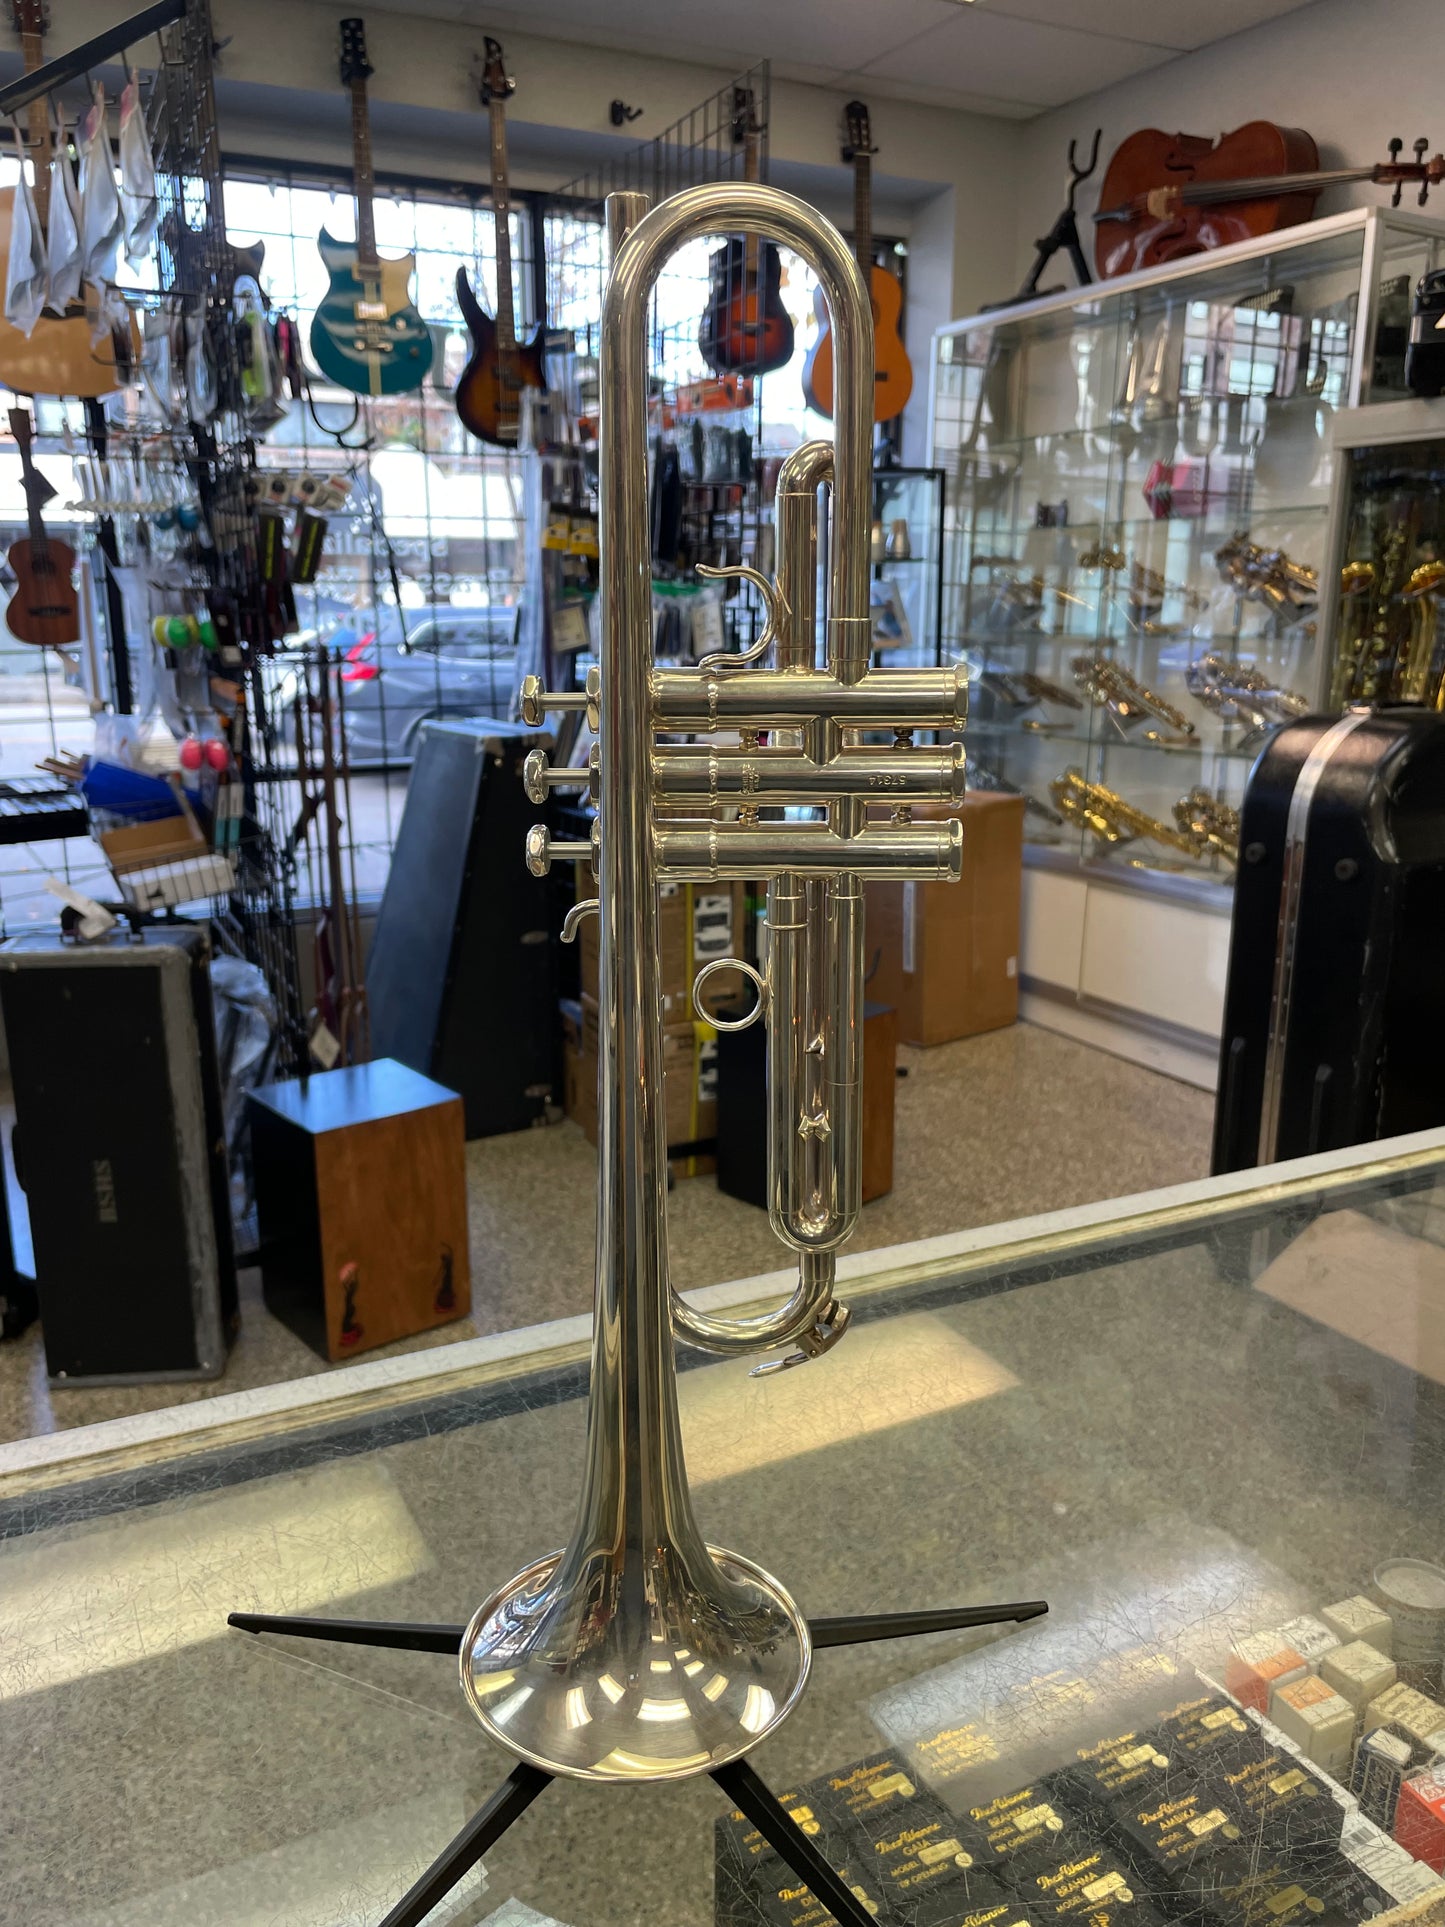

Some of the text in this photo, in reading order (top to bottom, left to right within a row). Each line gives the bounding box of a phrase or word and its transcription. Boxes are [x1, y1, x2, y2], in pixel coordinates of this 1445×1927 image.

[902, 1838, 932, 1856] GAIA
[1036, 1853, 1101, 1890] Theo Wanne
[1055, 1871, 1102, 1897] BRAHMA
[1055, 1894, 1086, 1913] MODEL
